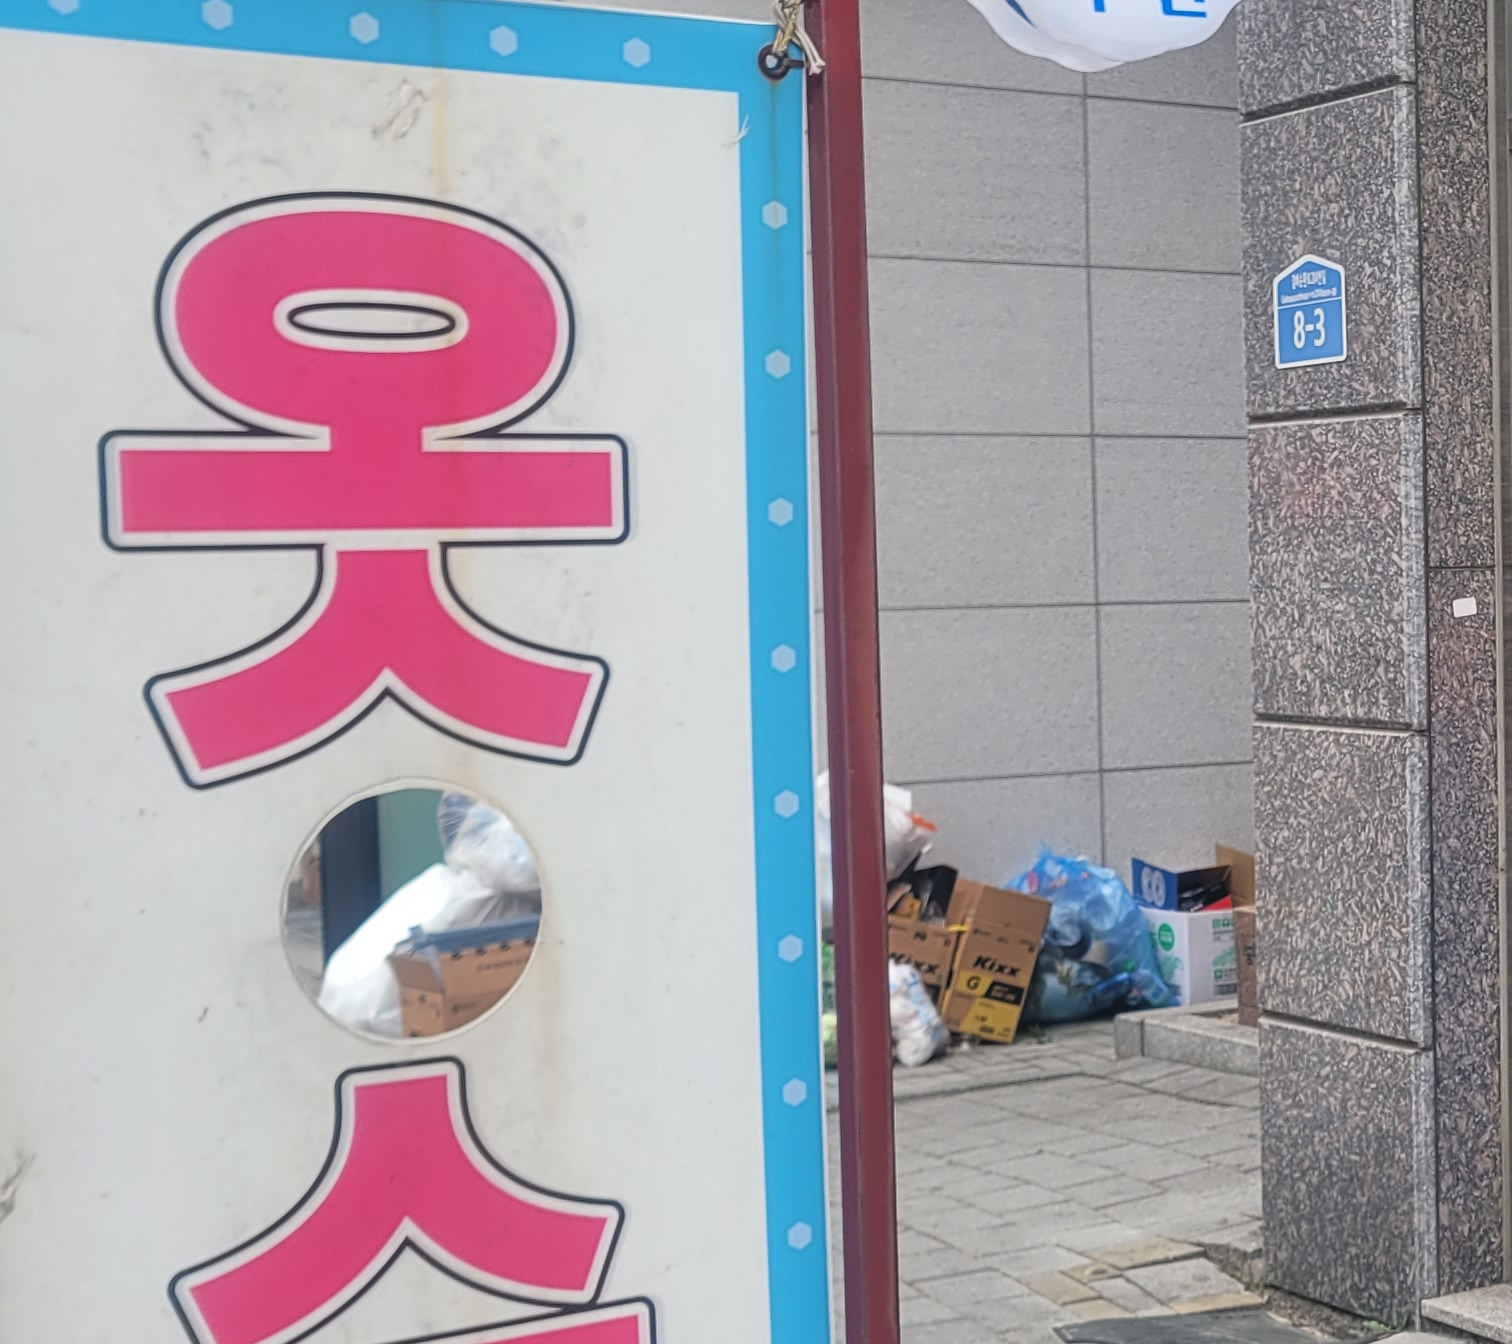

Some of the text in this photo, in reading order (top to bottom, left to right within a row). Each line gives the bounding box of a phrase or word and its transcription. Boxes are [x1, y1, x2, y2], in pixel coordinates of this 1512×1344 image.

[1293, 307, 1326, 349] 8-3
[974, 955, 1021, 978] Kixx
[966, 976, 981, 991] G
